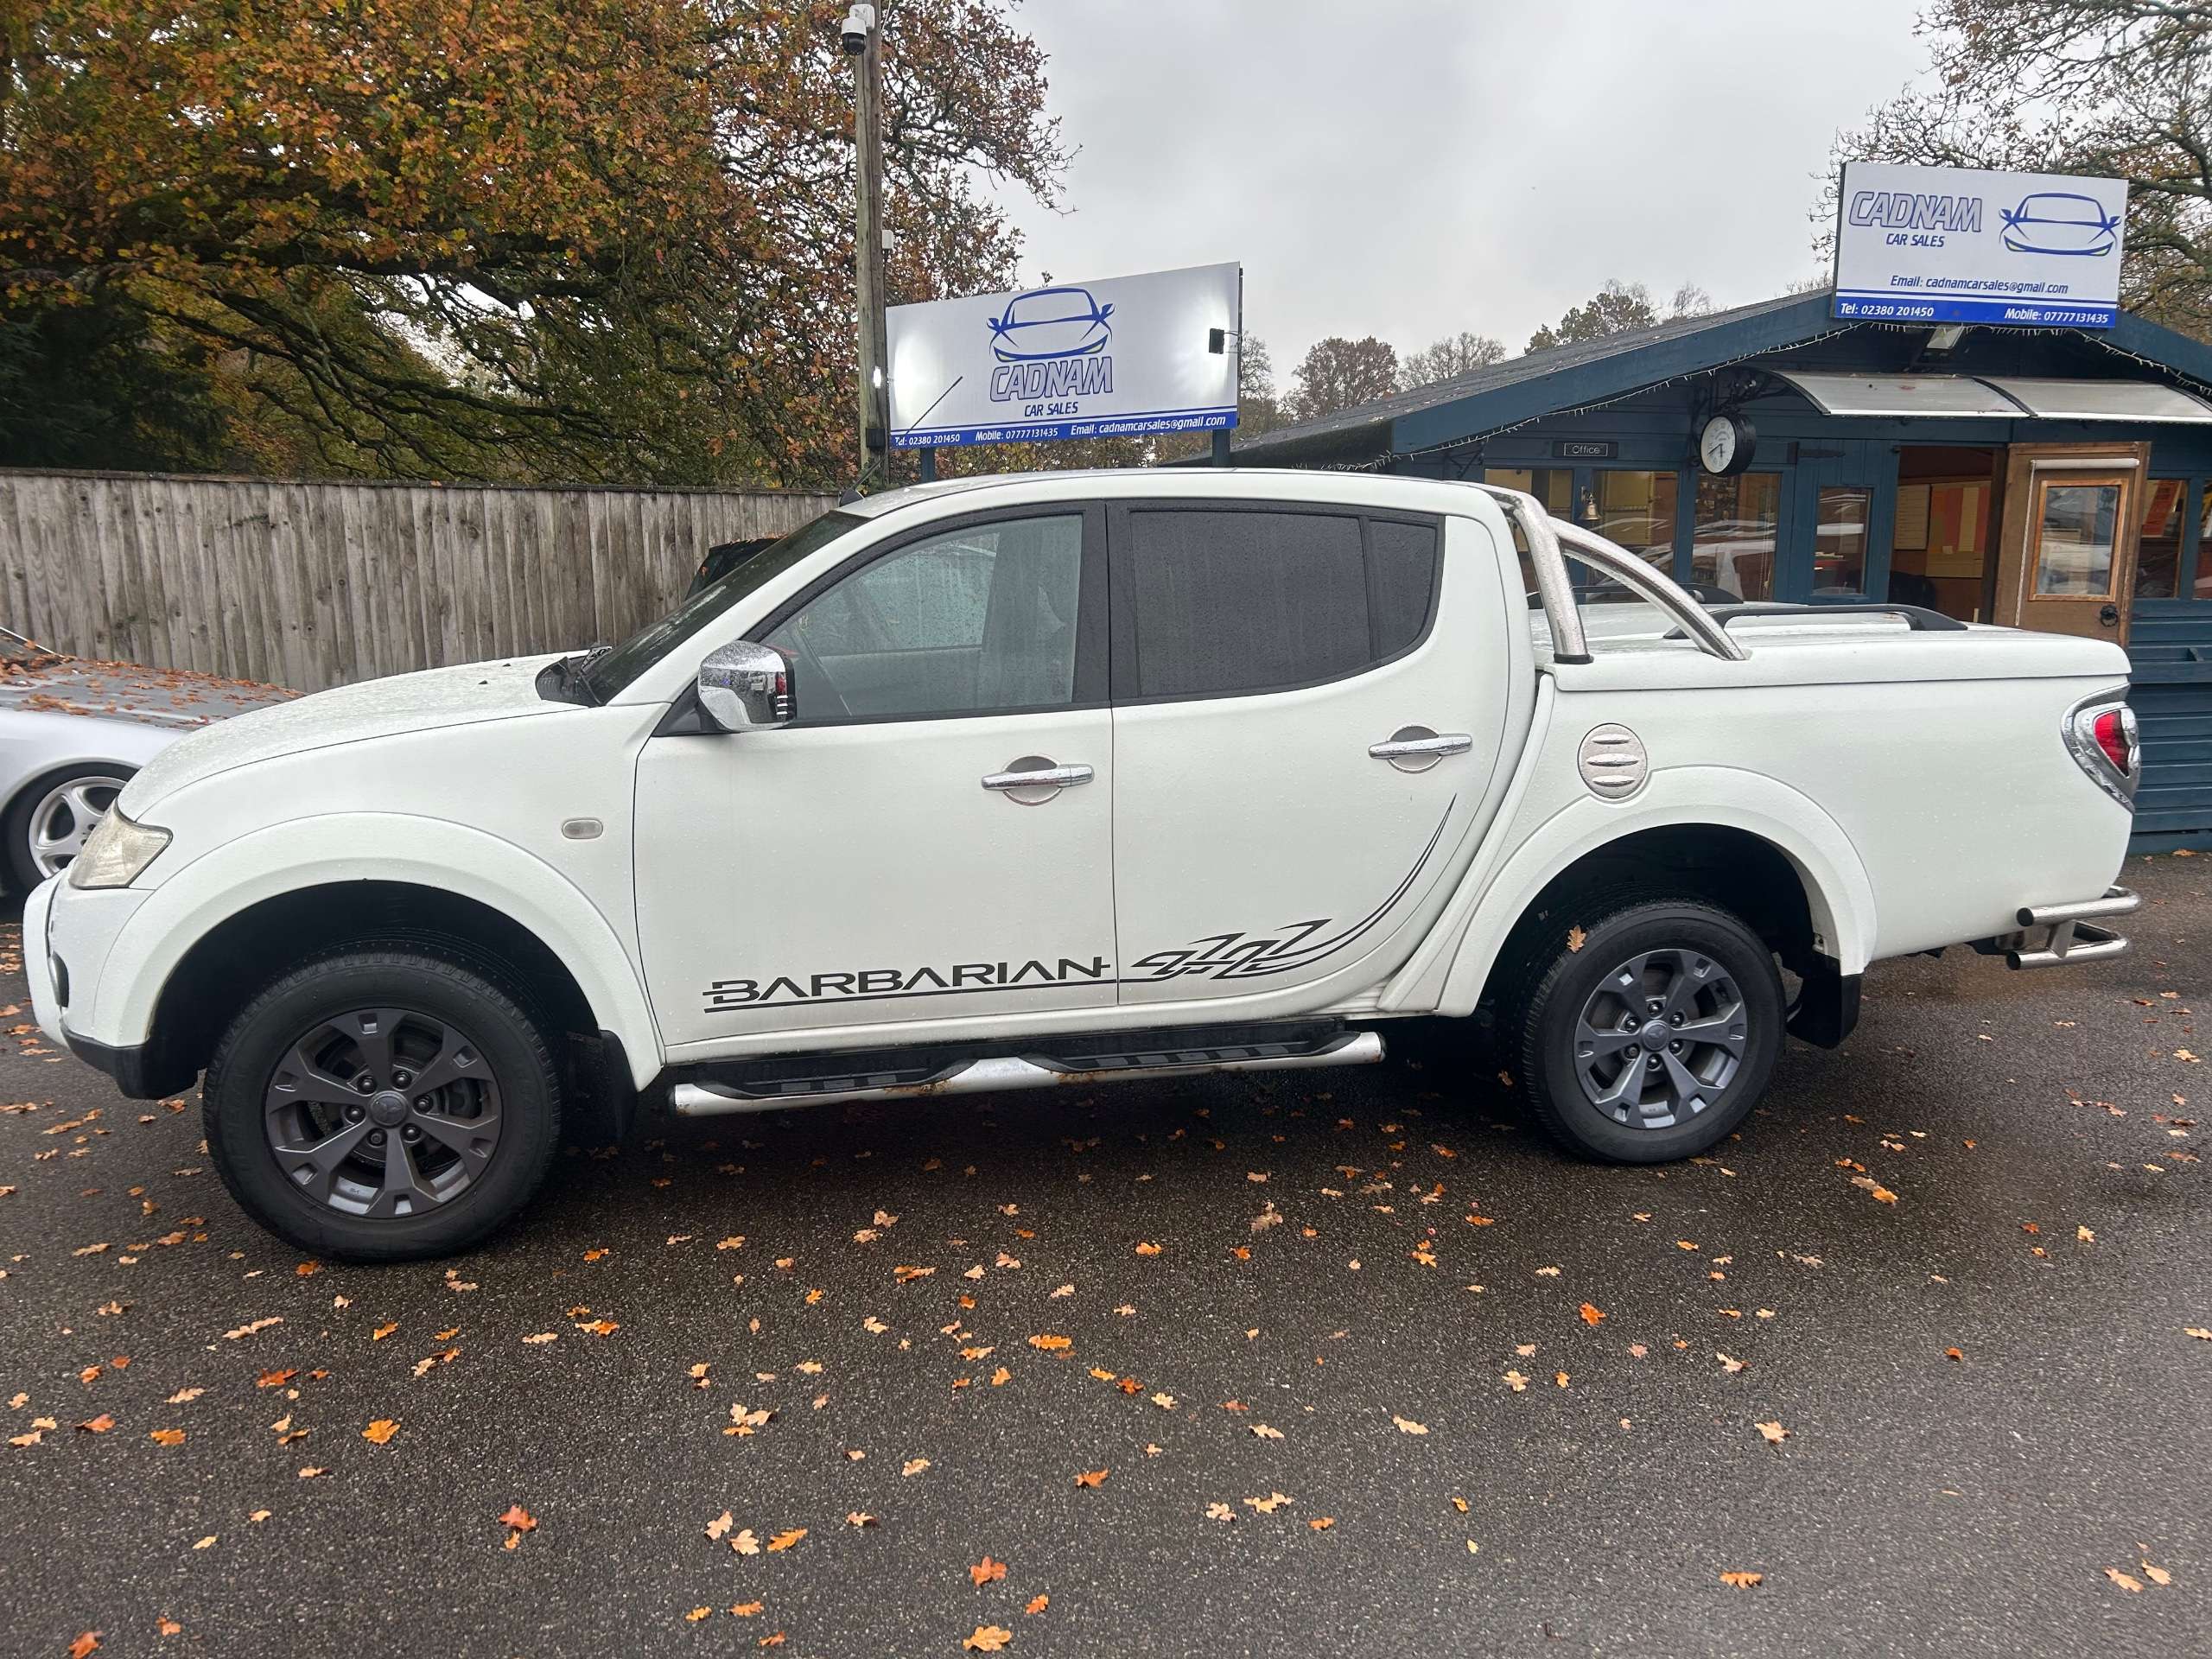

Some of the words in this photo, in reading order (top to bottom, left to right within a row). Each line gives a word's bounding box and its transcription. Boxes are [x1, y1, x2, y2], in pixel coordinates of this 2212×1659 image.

[1849, 191, 1982, 232] CADNAM
[1886, 233, 1907, 246] CAR
[1910, 234, 1945, 248] SALES
[1891, 275, 1923, 288] Email:
[1926, 276, 2069, 294] cadnamcarsales@gmail.com
[1840, 302, 1859, 315] Tel:
[1861, 305, 1894, 315] 02380
[1896, 306, 1934, 317] 201450
[2005, 308, 2042, 321] Mobile:
[2044, 311, 2108, 323] 07777131435
[990, 356, 1113, 402] CADNAM
[1024, 404, 1043, 417] CAR
[1046, 402, 1078, 416] SALES
[1071, 424, 1096, 435] Email:
[1099, 416, 1226, 434] cadnamcarsales@gmail.com
[895, 436, 907, 446] Tel:
[909, 435, 931, 446] 02380
[933, 434, 960, 444] 201450
[976, 430, 1003, 441] Mobile:
[1006, 428, 1058, 439] 07777131435
[1573, 445, 1600, 454] Office
[702, 956, 1110, 1005] BARBARIAN
